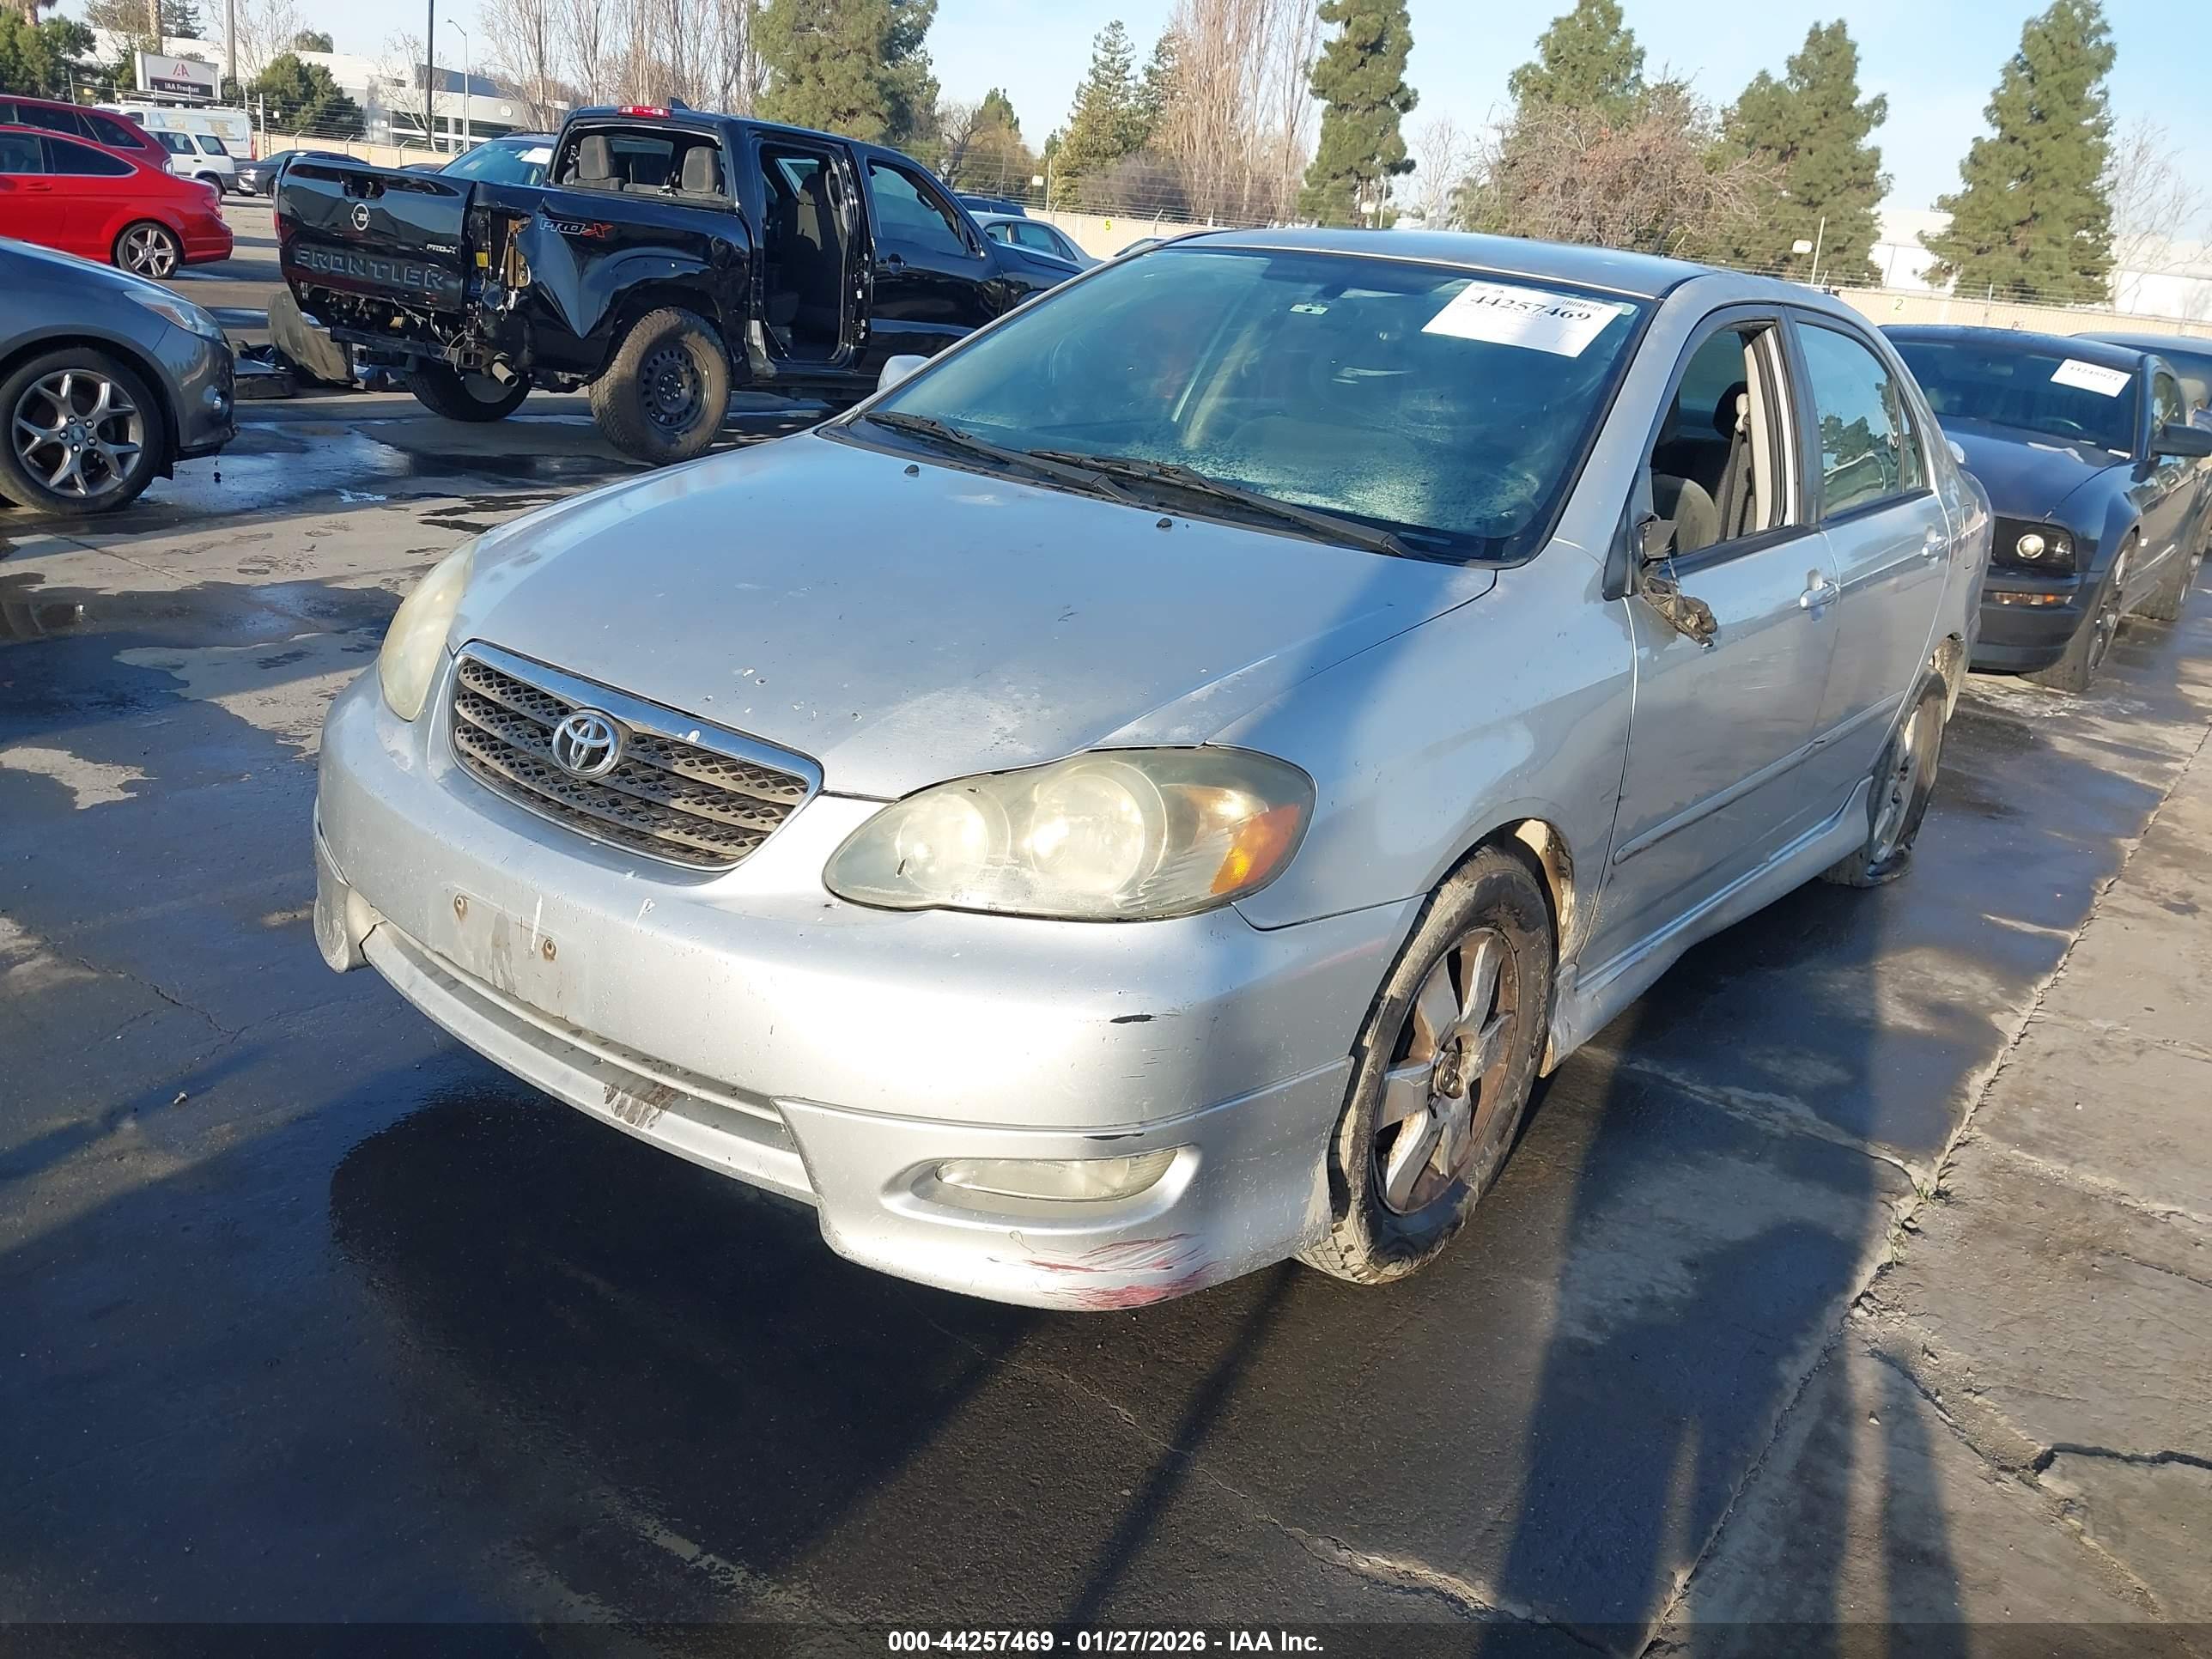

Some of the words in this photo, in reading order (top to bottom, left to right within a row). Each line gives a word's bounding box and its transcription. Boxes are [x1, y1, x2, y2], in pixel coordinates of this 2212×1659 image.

[539, 218, 614, 238] PRO-X
[1105, 220, 1111, 231] 5
[295, 249, 444, 290] FRONTIER
[1469, 295, 1592, 321] 44257469
[1894, 298, 1904, 311] 2
